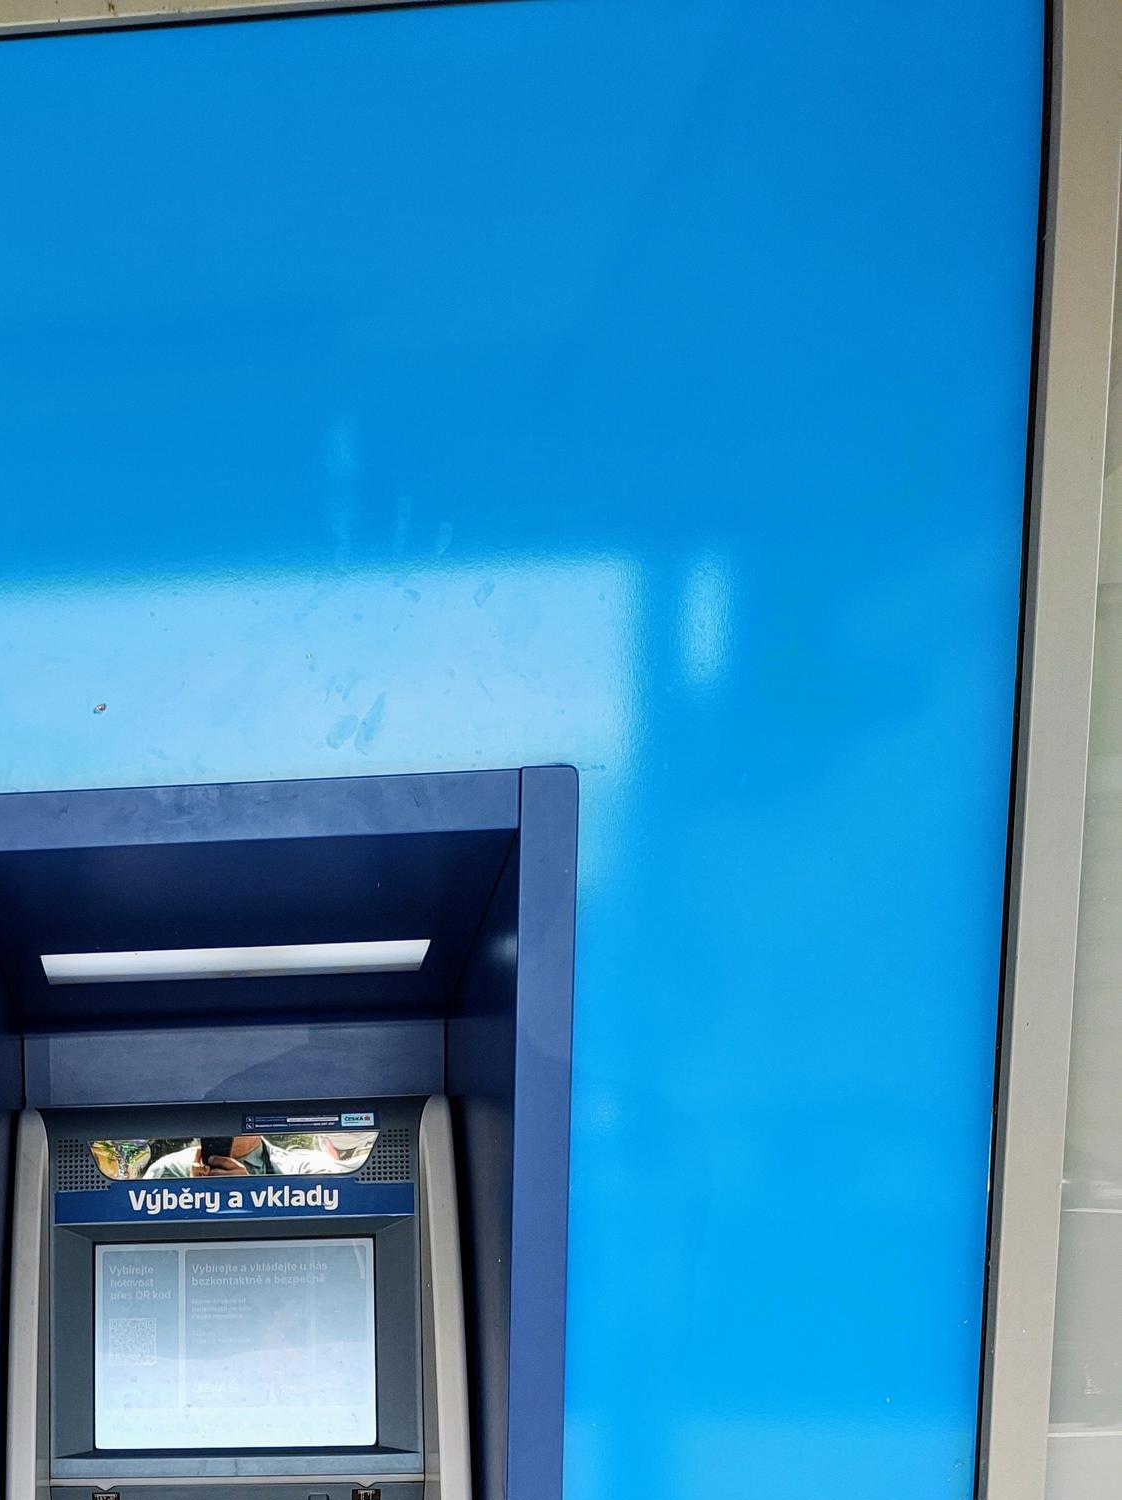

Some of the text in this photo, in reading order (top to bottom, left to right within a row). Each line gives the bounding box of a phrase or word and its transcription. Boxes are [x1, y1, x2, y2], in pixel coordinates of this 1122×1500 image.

[128, 1184, 339, 1215] Výběry a vklady
